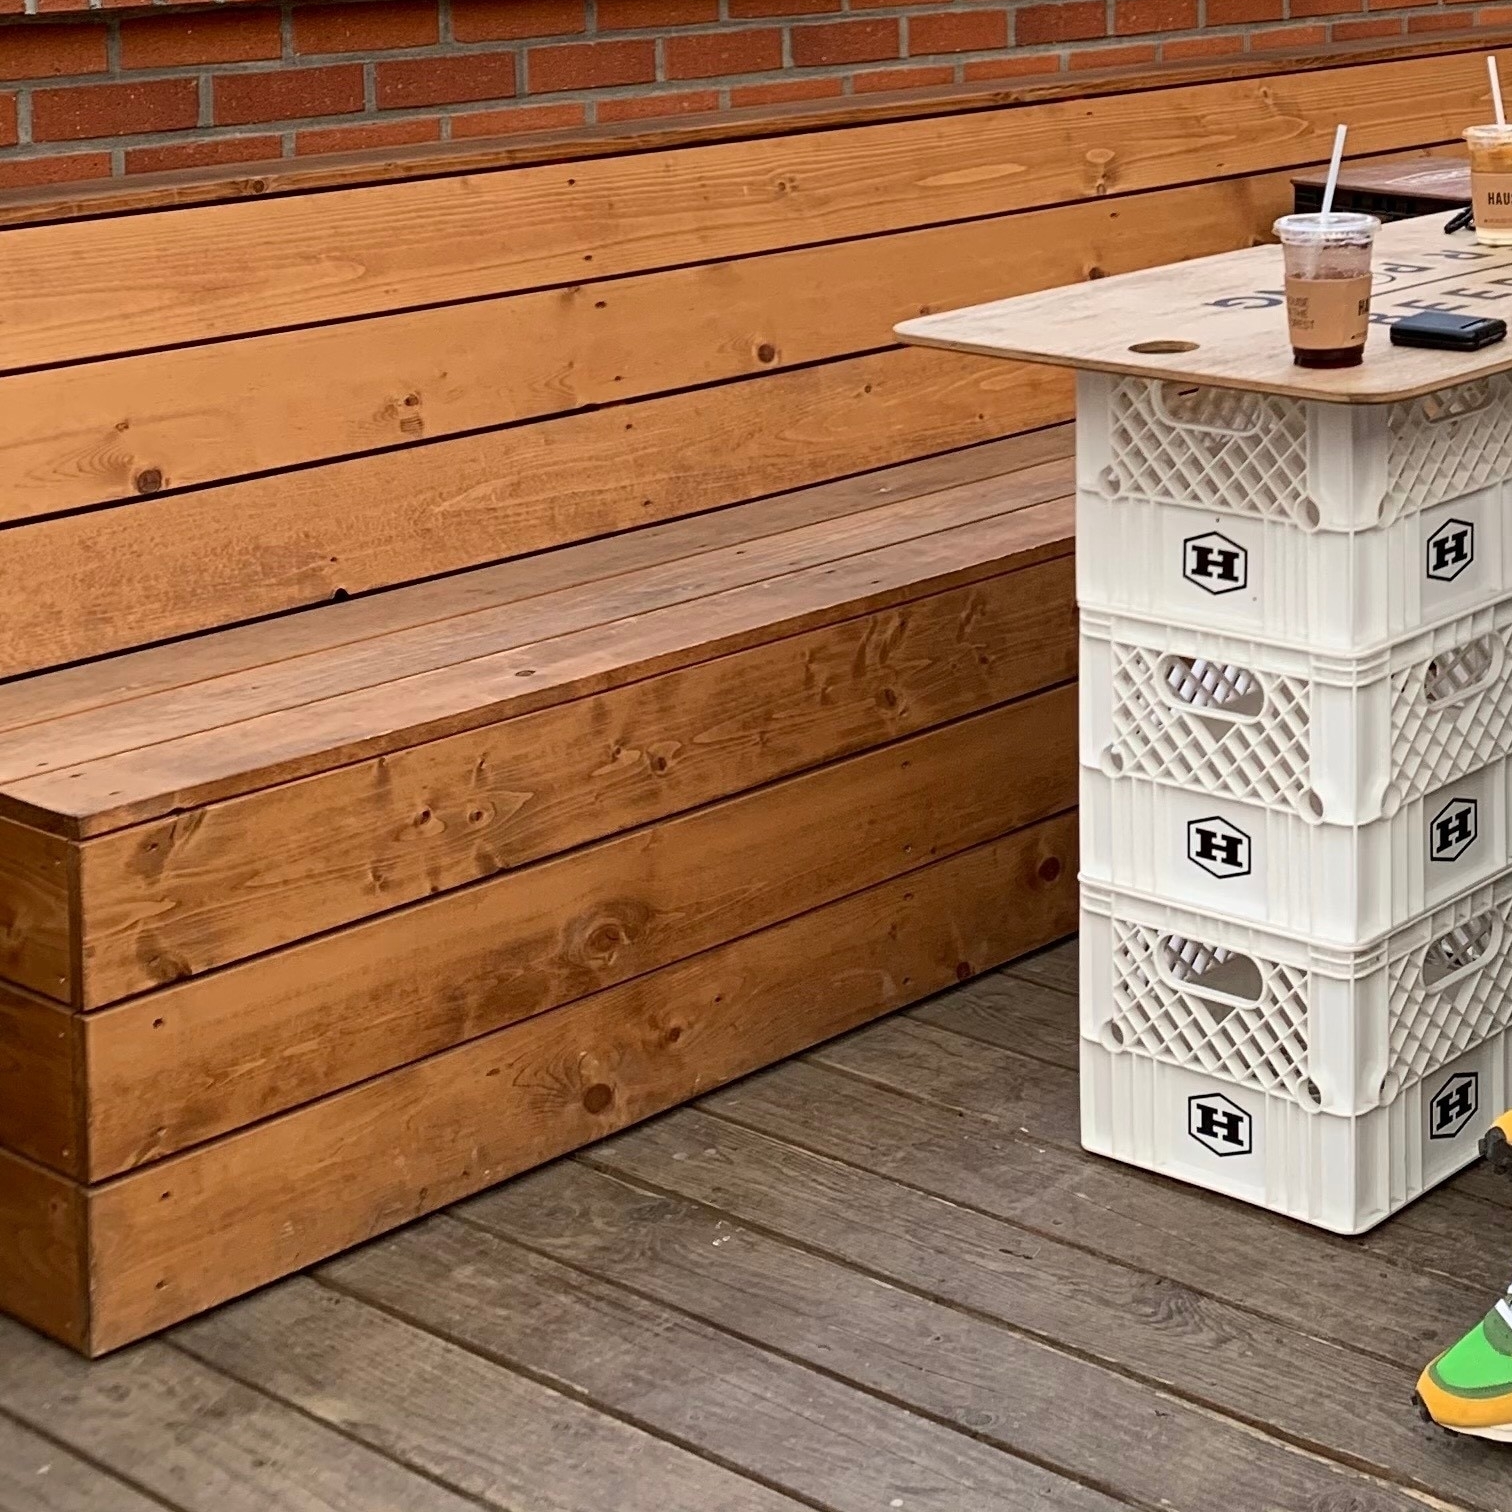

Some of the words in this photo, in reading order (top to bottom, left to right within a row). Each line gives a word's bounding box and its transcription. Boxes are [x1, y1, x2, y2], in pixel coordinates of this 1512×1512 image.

[1192, 544, 1239, 583] H
[1432, 529, 1468, 572] H
[1195, 828, 1243, 869] H
[1435, 806, 1471, 854] H
[1197, 1103, 1244, 1147] H
[1435, 1079, 1473, 1132] H
